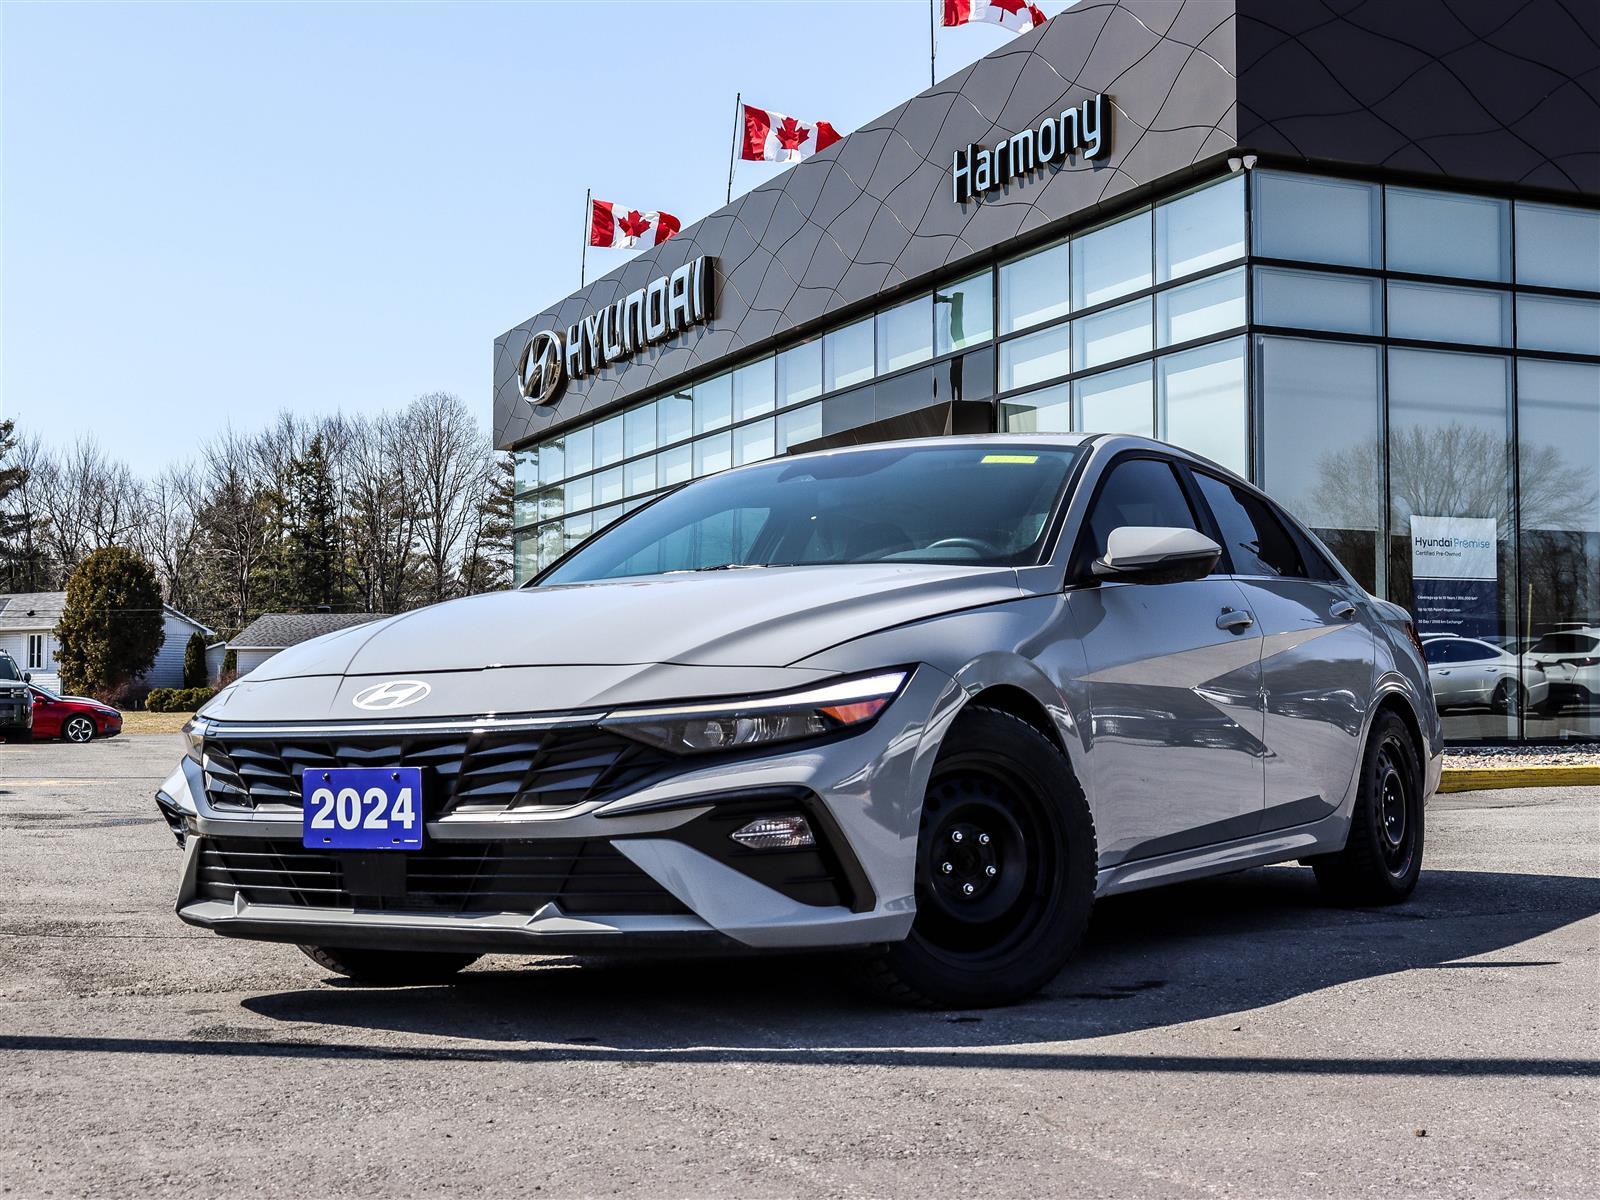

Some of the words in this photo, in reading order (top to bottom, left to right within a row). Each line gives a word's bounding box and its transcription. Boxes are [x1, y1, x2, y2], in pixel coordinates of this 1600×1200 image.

[953, 93, 1108, 203] Harmony
[565, 256, 712, 380] HYUNDAI
[1415, 536, 1453, 548] Hyundai
[310, 787, 416, 830] 2024
